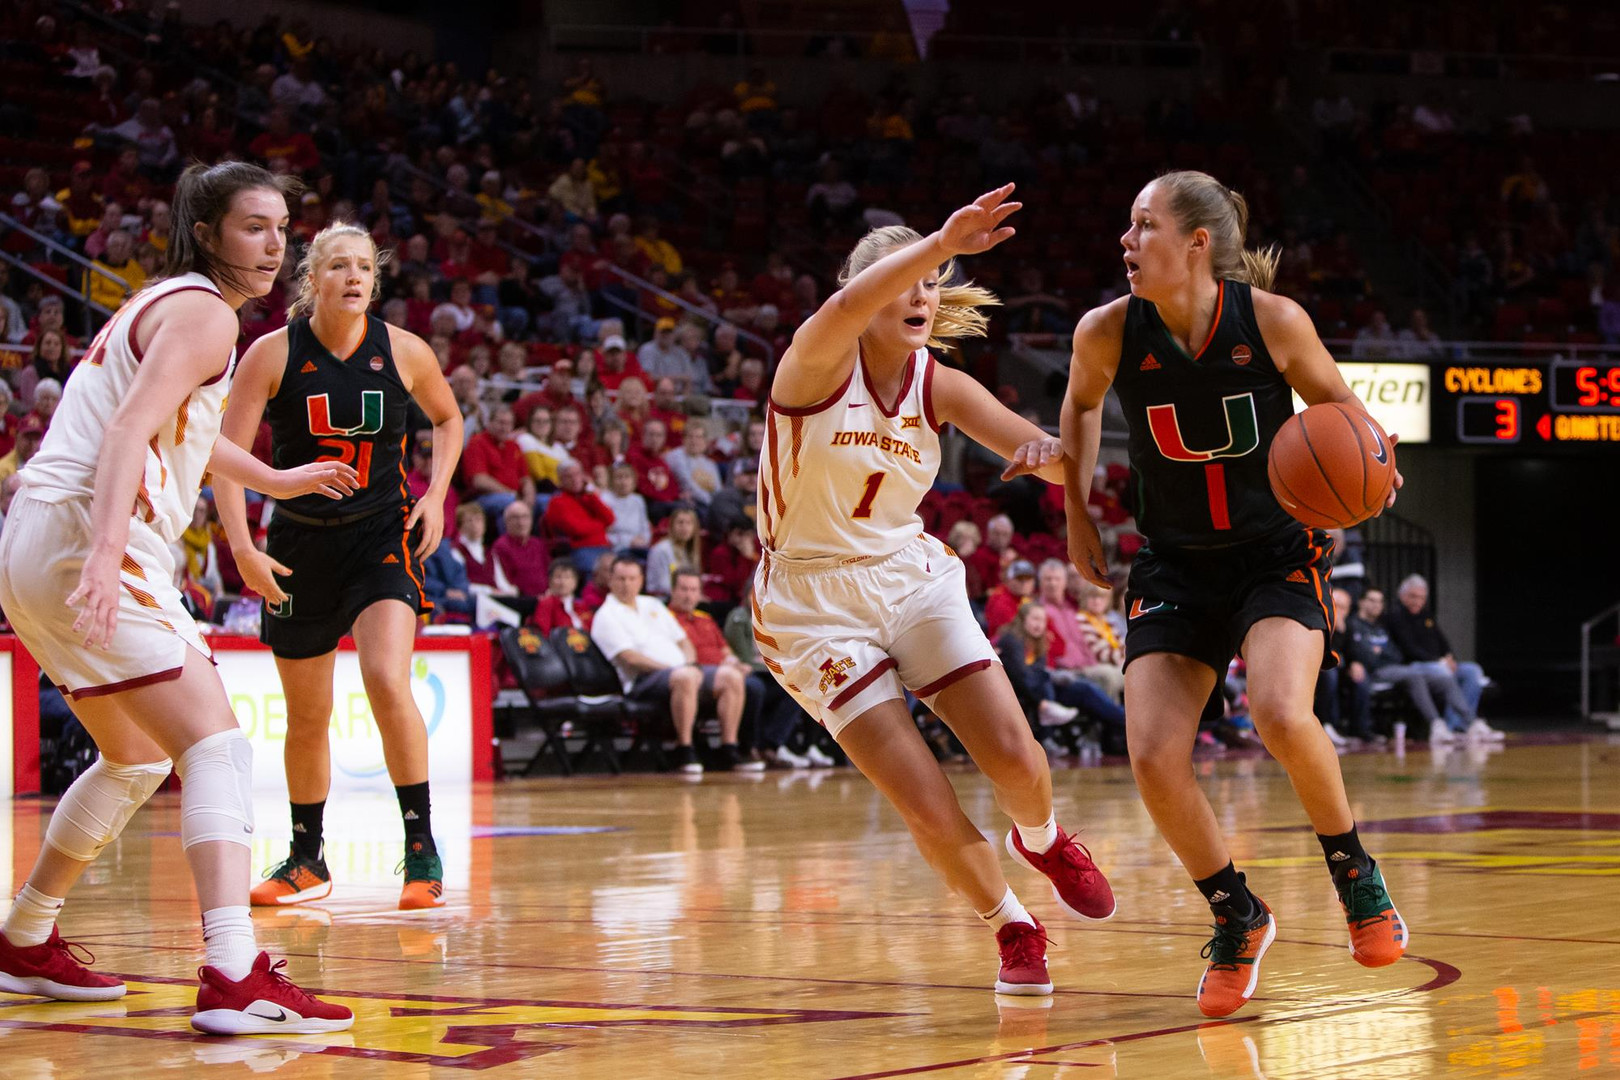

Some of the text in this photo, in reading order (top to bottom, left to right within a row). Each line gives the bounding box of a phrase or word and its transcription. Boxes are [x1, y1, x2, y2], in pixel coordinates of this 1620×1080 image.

[307, 391, 383, 436] U
[1146, 392, 1259, 462] U
[1496, 400, 1517, 439] 3
[830, 431, 922, 465] IOWA STATE
[851, 471, 885, 519] 1
[1205, 463, 1232, 530] 1
